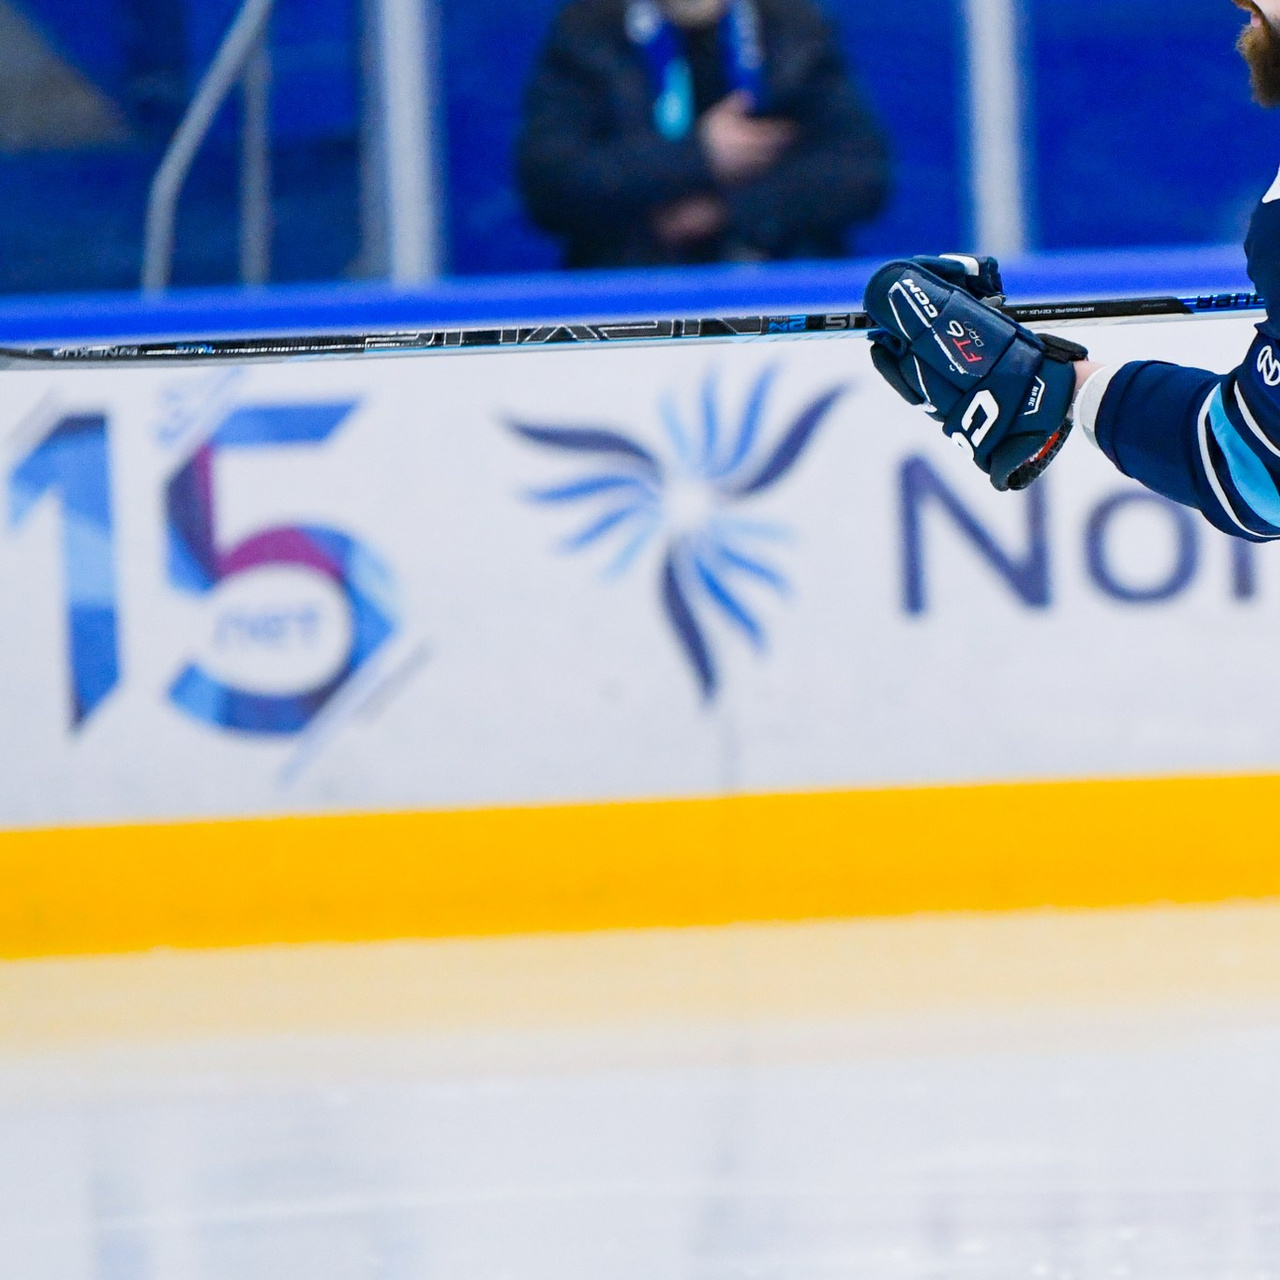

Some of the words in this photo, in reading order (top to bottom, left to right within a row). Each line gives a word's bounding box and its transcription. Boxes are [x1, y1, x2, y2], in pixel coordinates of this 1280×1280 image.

[902, 278, 939, 318] CCM
[947, 319, 984, 364] FT6
[8, 394, 403, 742] 15
